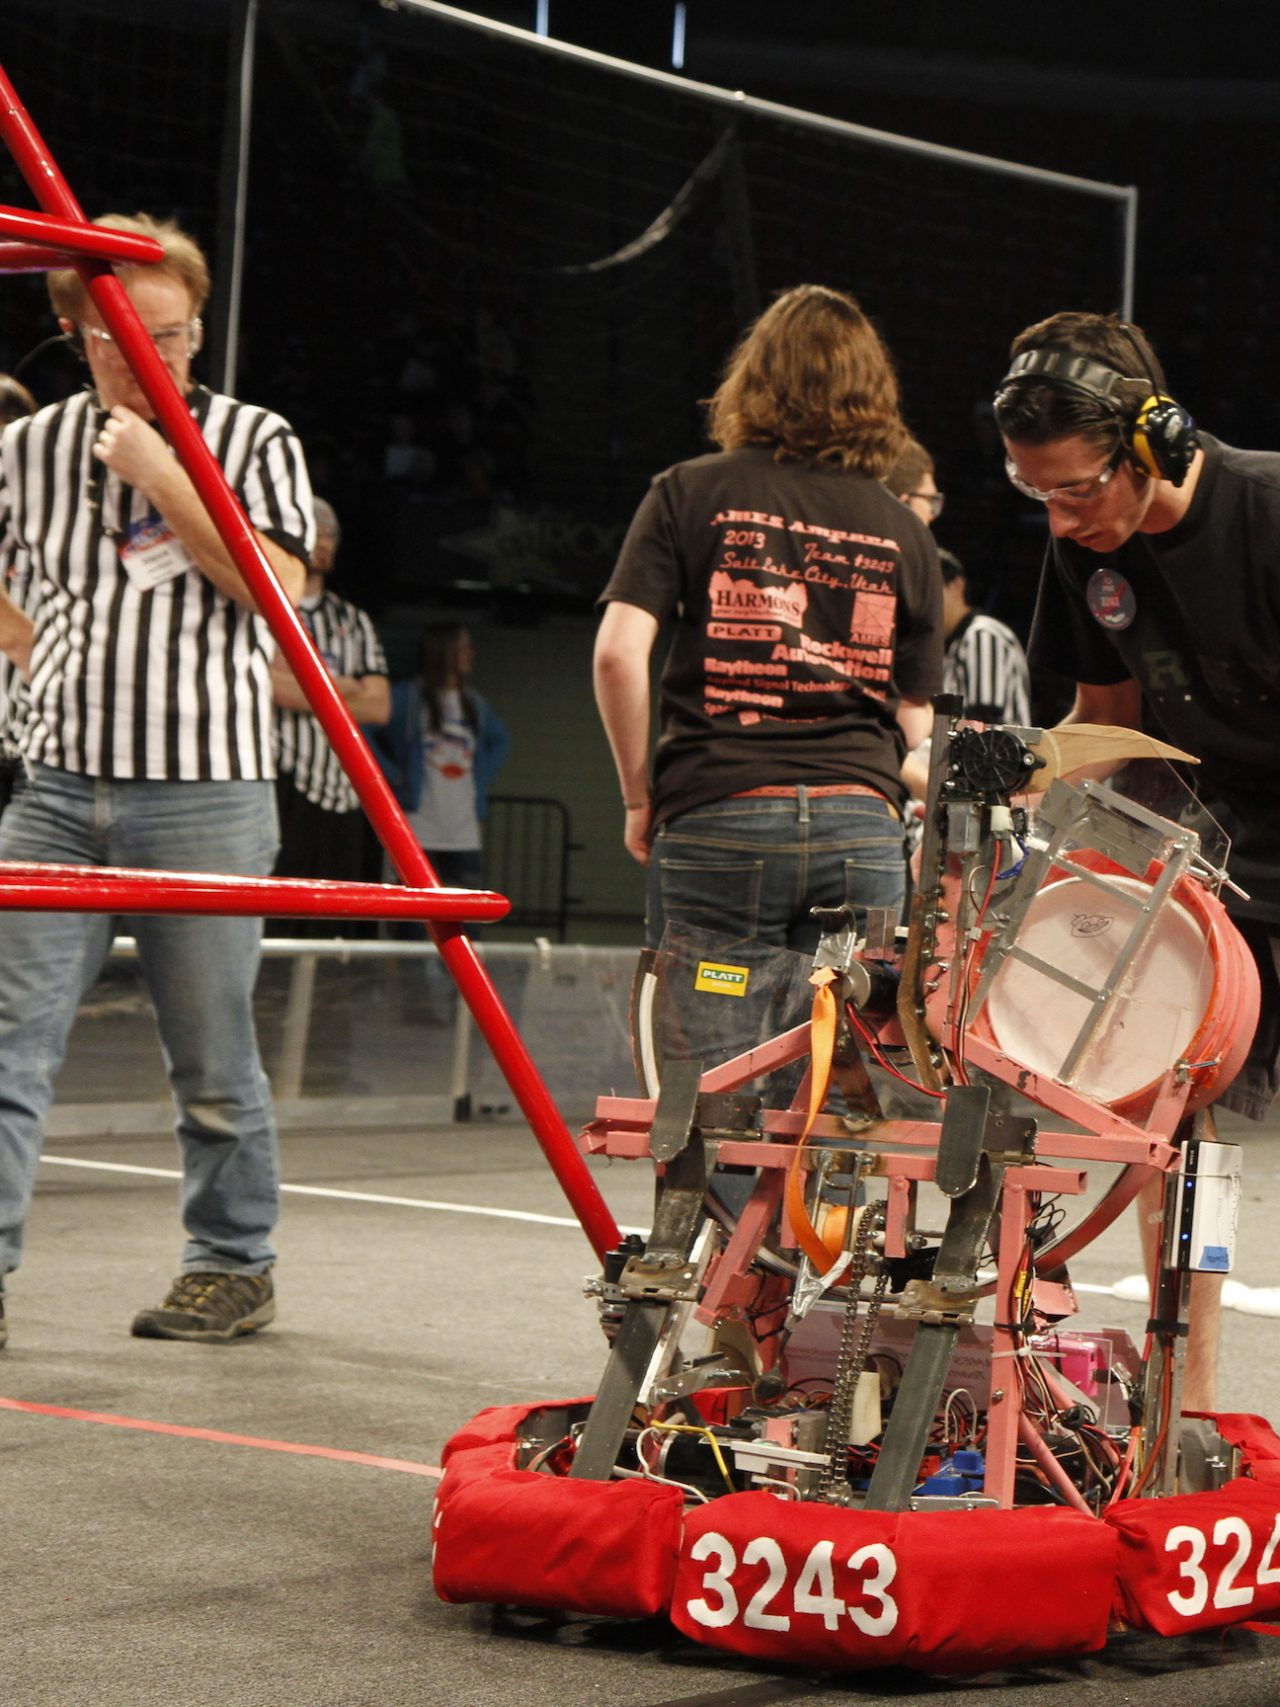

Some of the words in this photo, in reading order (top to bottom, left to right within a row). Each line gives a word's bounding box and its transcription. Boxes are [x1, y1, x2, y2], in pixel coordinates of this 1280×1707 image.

[723, 530, 766, 549] 2013
[804, 542, 850, 563] Team
[713, 626, 774, 639] PLATT
[800, 633, 893, 666] Rockwell
[704, 657, 788, 676] Raytheon
[754, 678, 789, 691] Signal
[704, 685, 784, 708] Raytheon
[702, 969, 743, 982] PLATT
[687, 1532, 899, 1636] 3243
